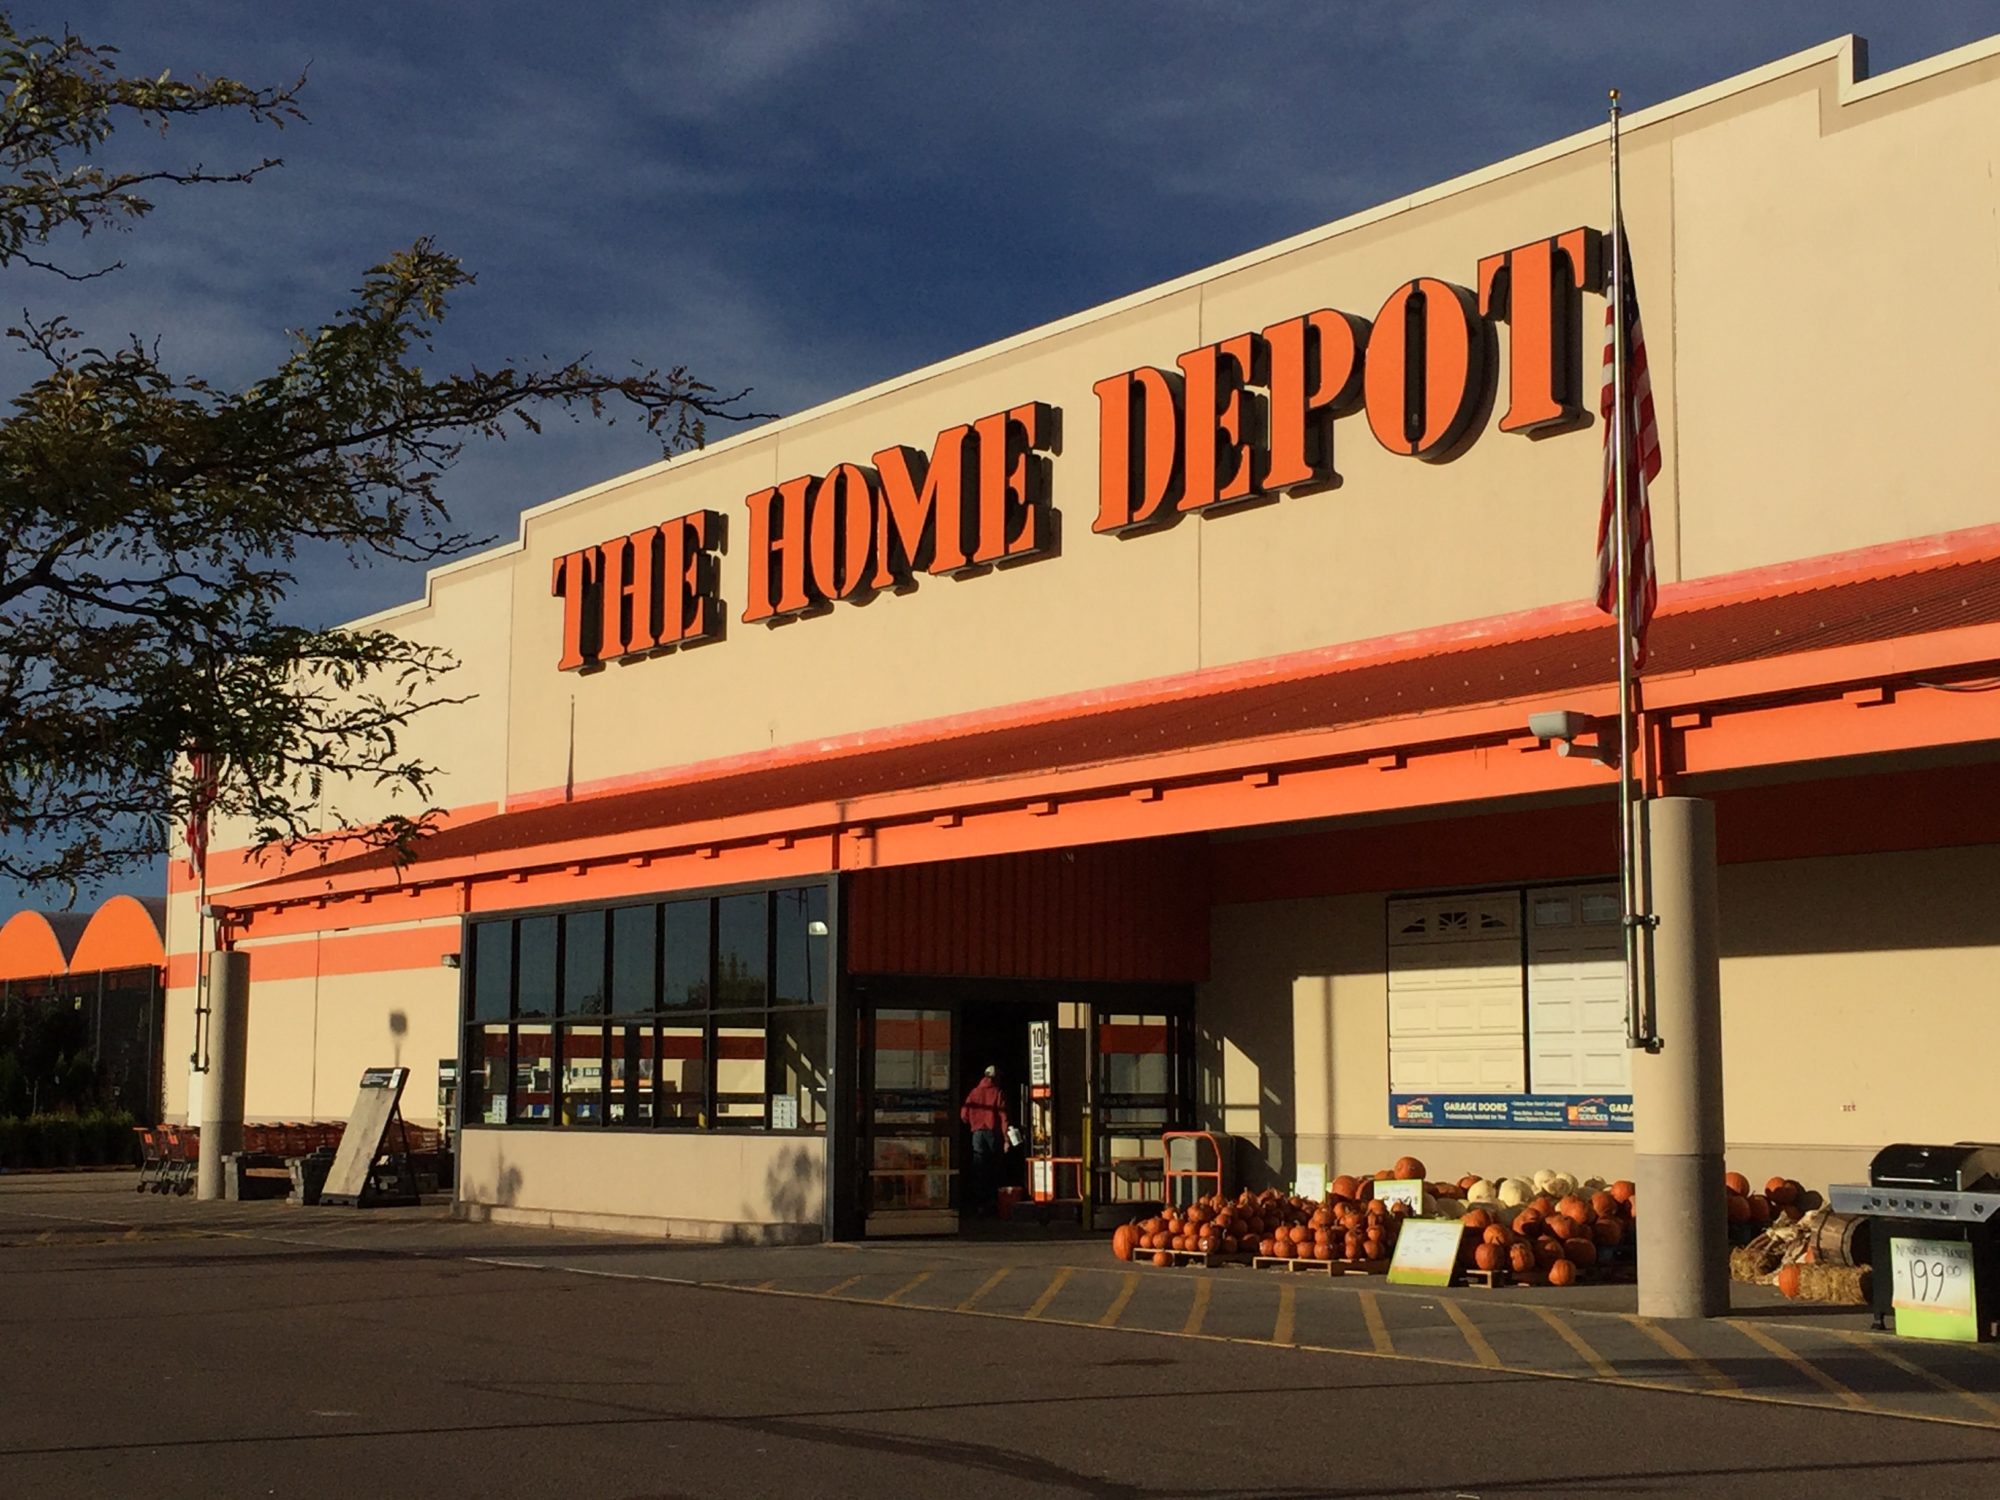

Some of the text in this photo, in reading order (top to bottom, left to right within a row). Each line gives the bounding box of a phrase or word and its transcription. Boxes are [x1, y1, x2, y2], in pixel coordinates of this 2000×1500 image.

[552, 226, 1602, 672] THE HOME DEPOT
[1443, 1101, 1477, 1111] GARAGE
[1478, 1102, 1508, 1111] DOORS
